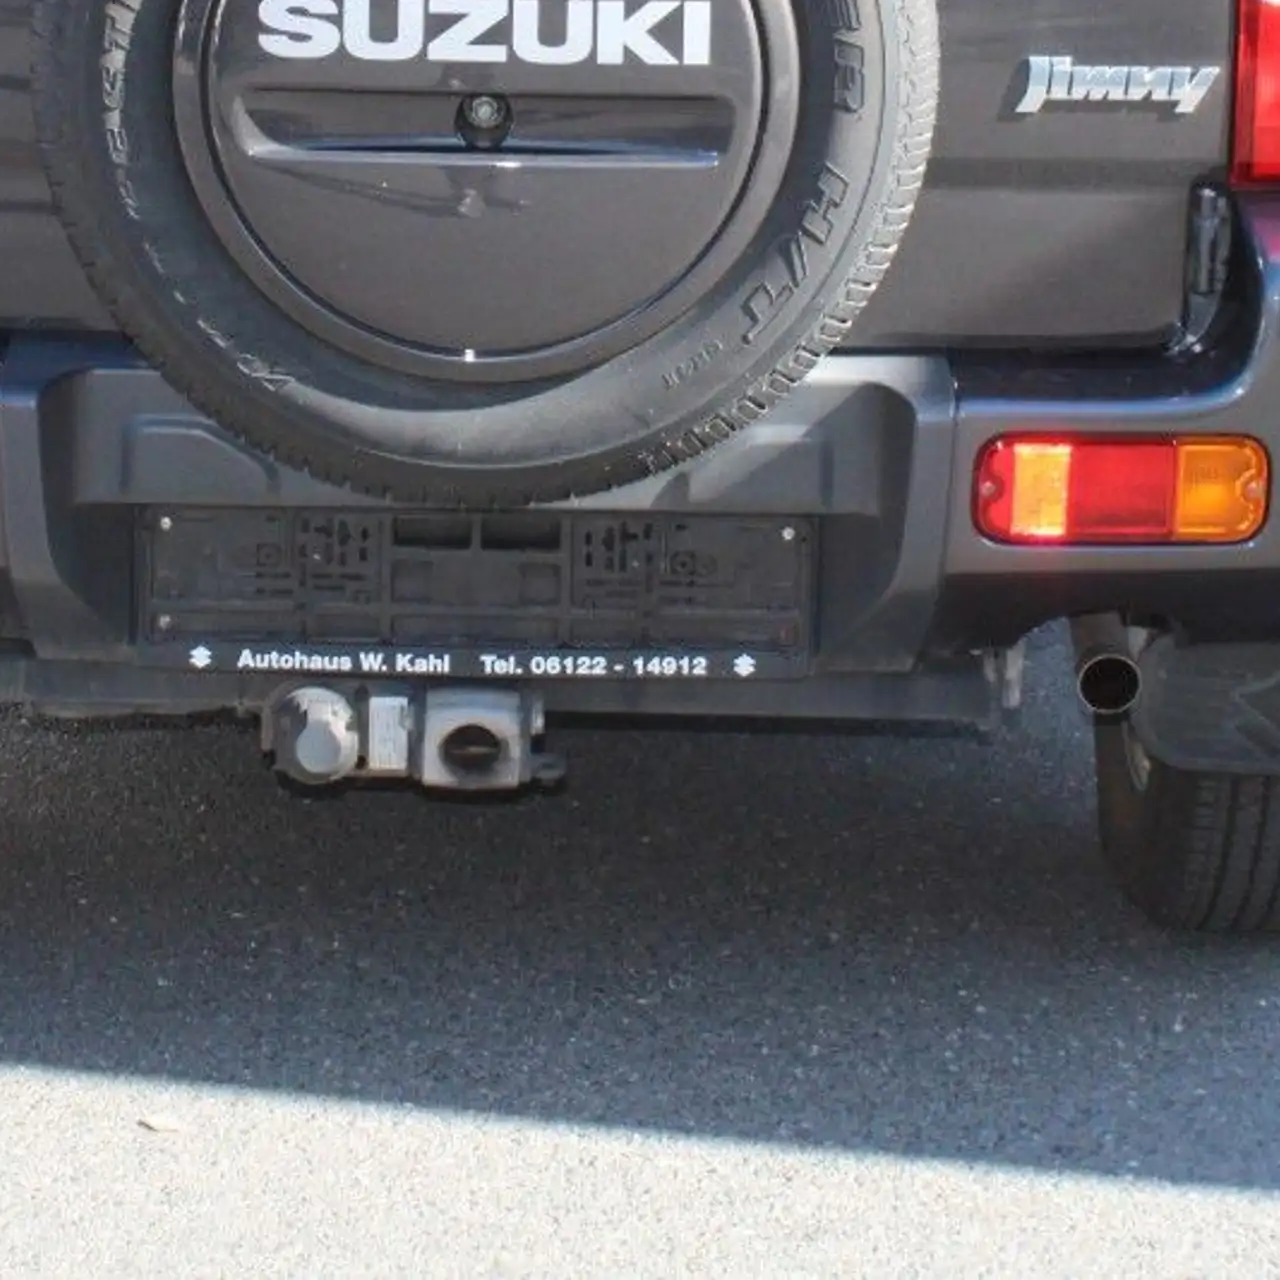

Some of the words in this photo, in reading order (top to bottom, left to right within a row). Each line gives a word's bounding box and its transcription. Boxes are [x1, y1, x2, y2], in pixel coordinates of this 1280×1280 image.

[1014, 55, 1221, 114] Jimny
[236, 648, 352, 671] Autohaus
[359, 651, 388, 672] W.
[396, 652, 451, 673] Kahl
[479, 653, 523, 675] Tel.
[530, 655, 608, 675] 06122
[632, 655, 708, 677] 14912
